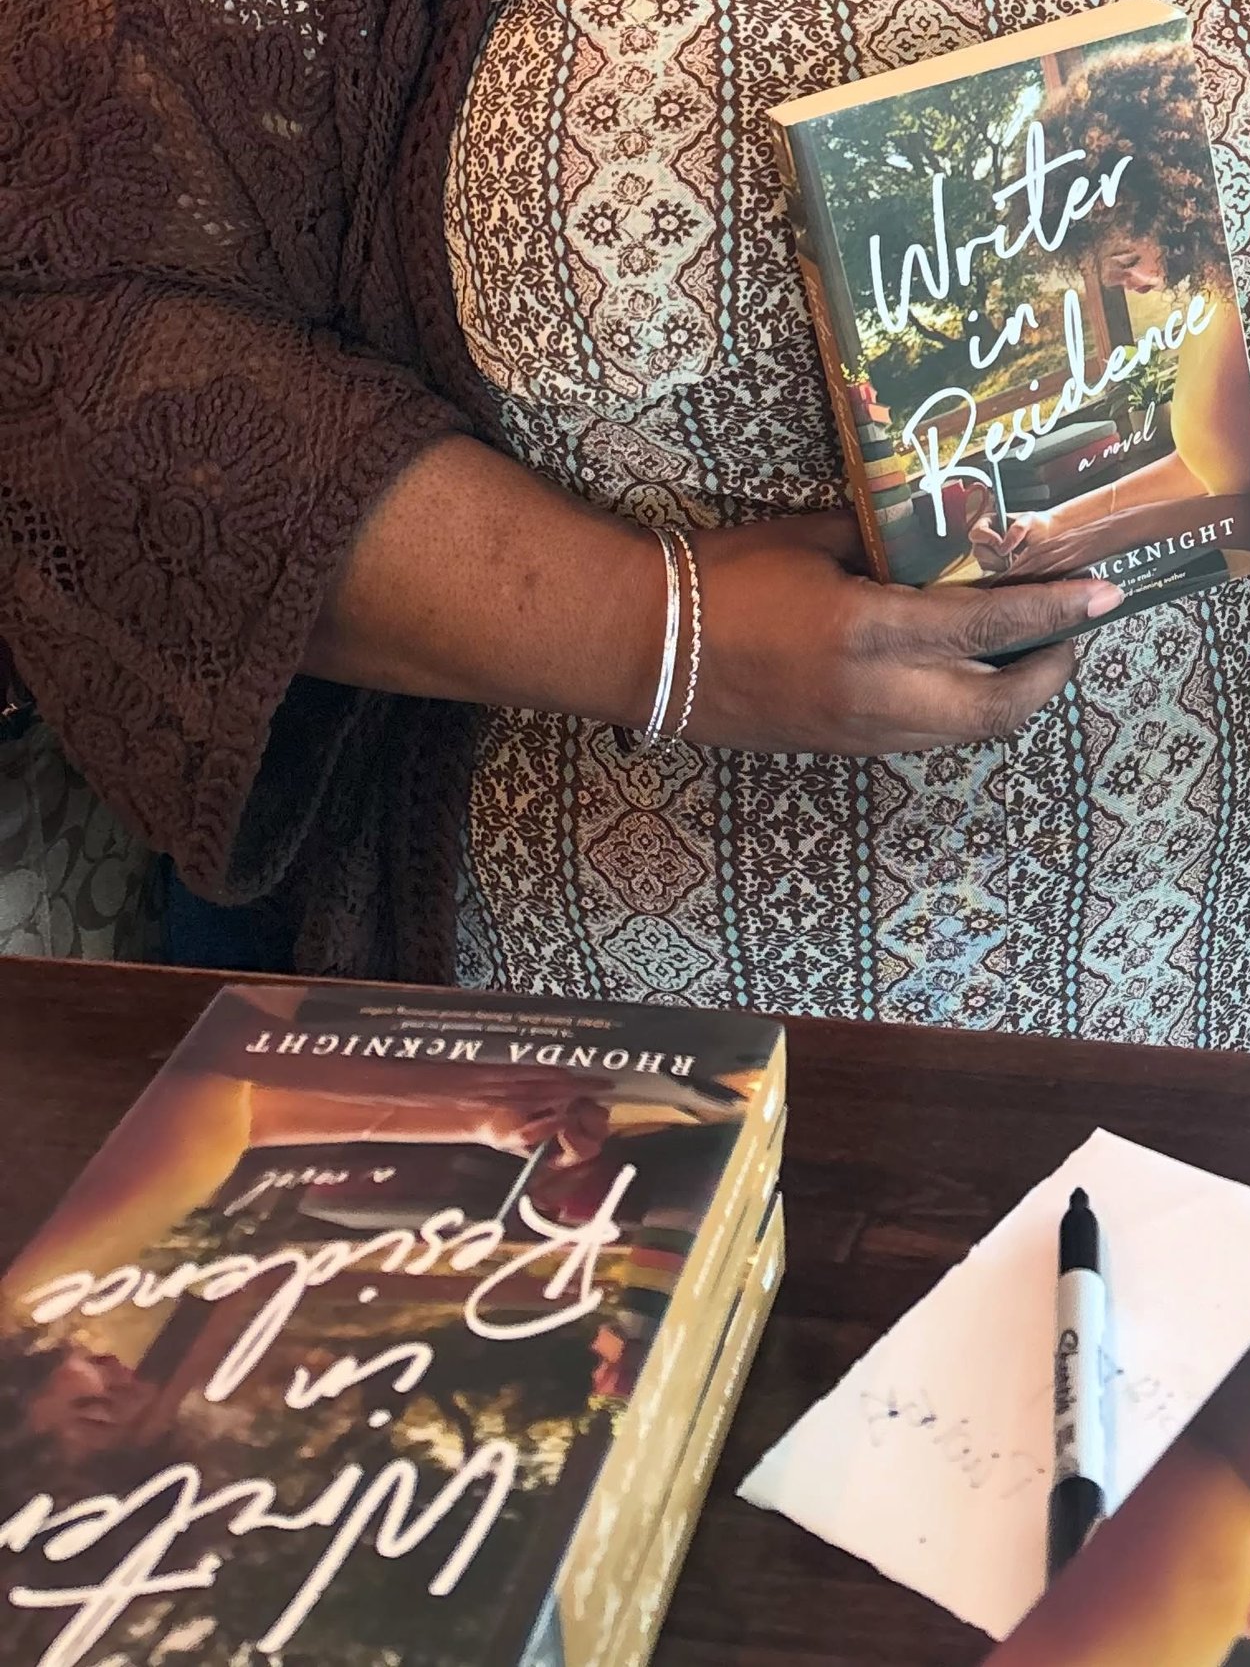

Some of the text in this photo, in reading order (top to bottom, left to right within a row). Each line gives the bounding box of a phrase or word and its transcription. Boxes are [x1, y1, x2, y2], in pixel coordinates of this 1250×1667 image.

[868, 120, 1135, 334] Writer
[968, 300, 1040, 370] in
[903, 288, 1218, 537] Residence
[1077, 400, 1157, 472] a novel
[1089, 517, 1235, 581] McKNIGHT
[245, 1029, 484, 1063] McKNIGHT
[506, 1040, 696, 1078] RHONDA
[223, 1167, 350, 1218] novel
[31, 1163, 638, 1401] Residence
[284, 1339, 435, 1428] in
